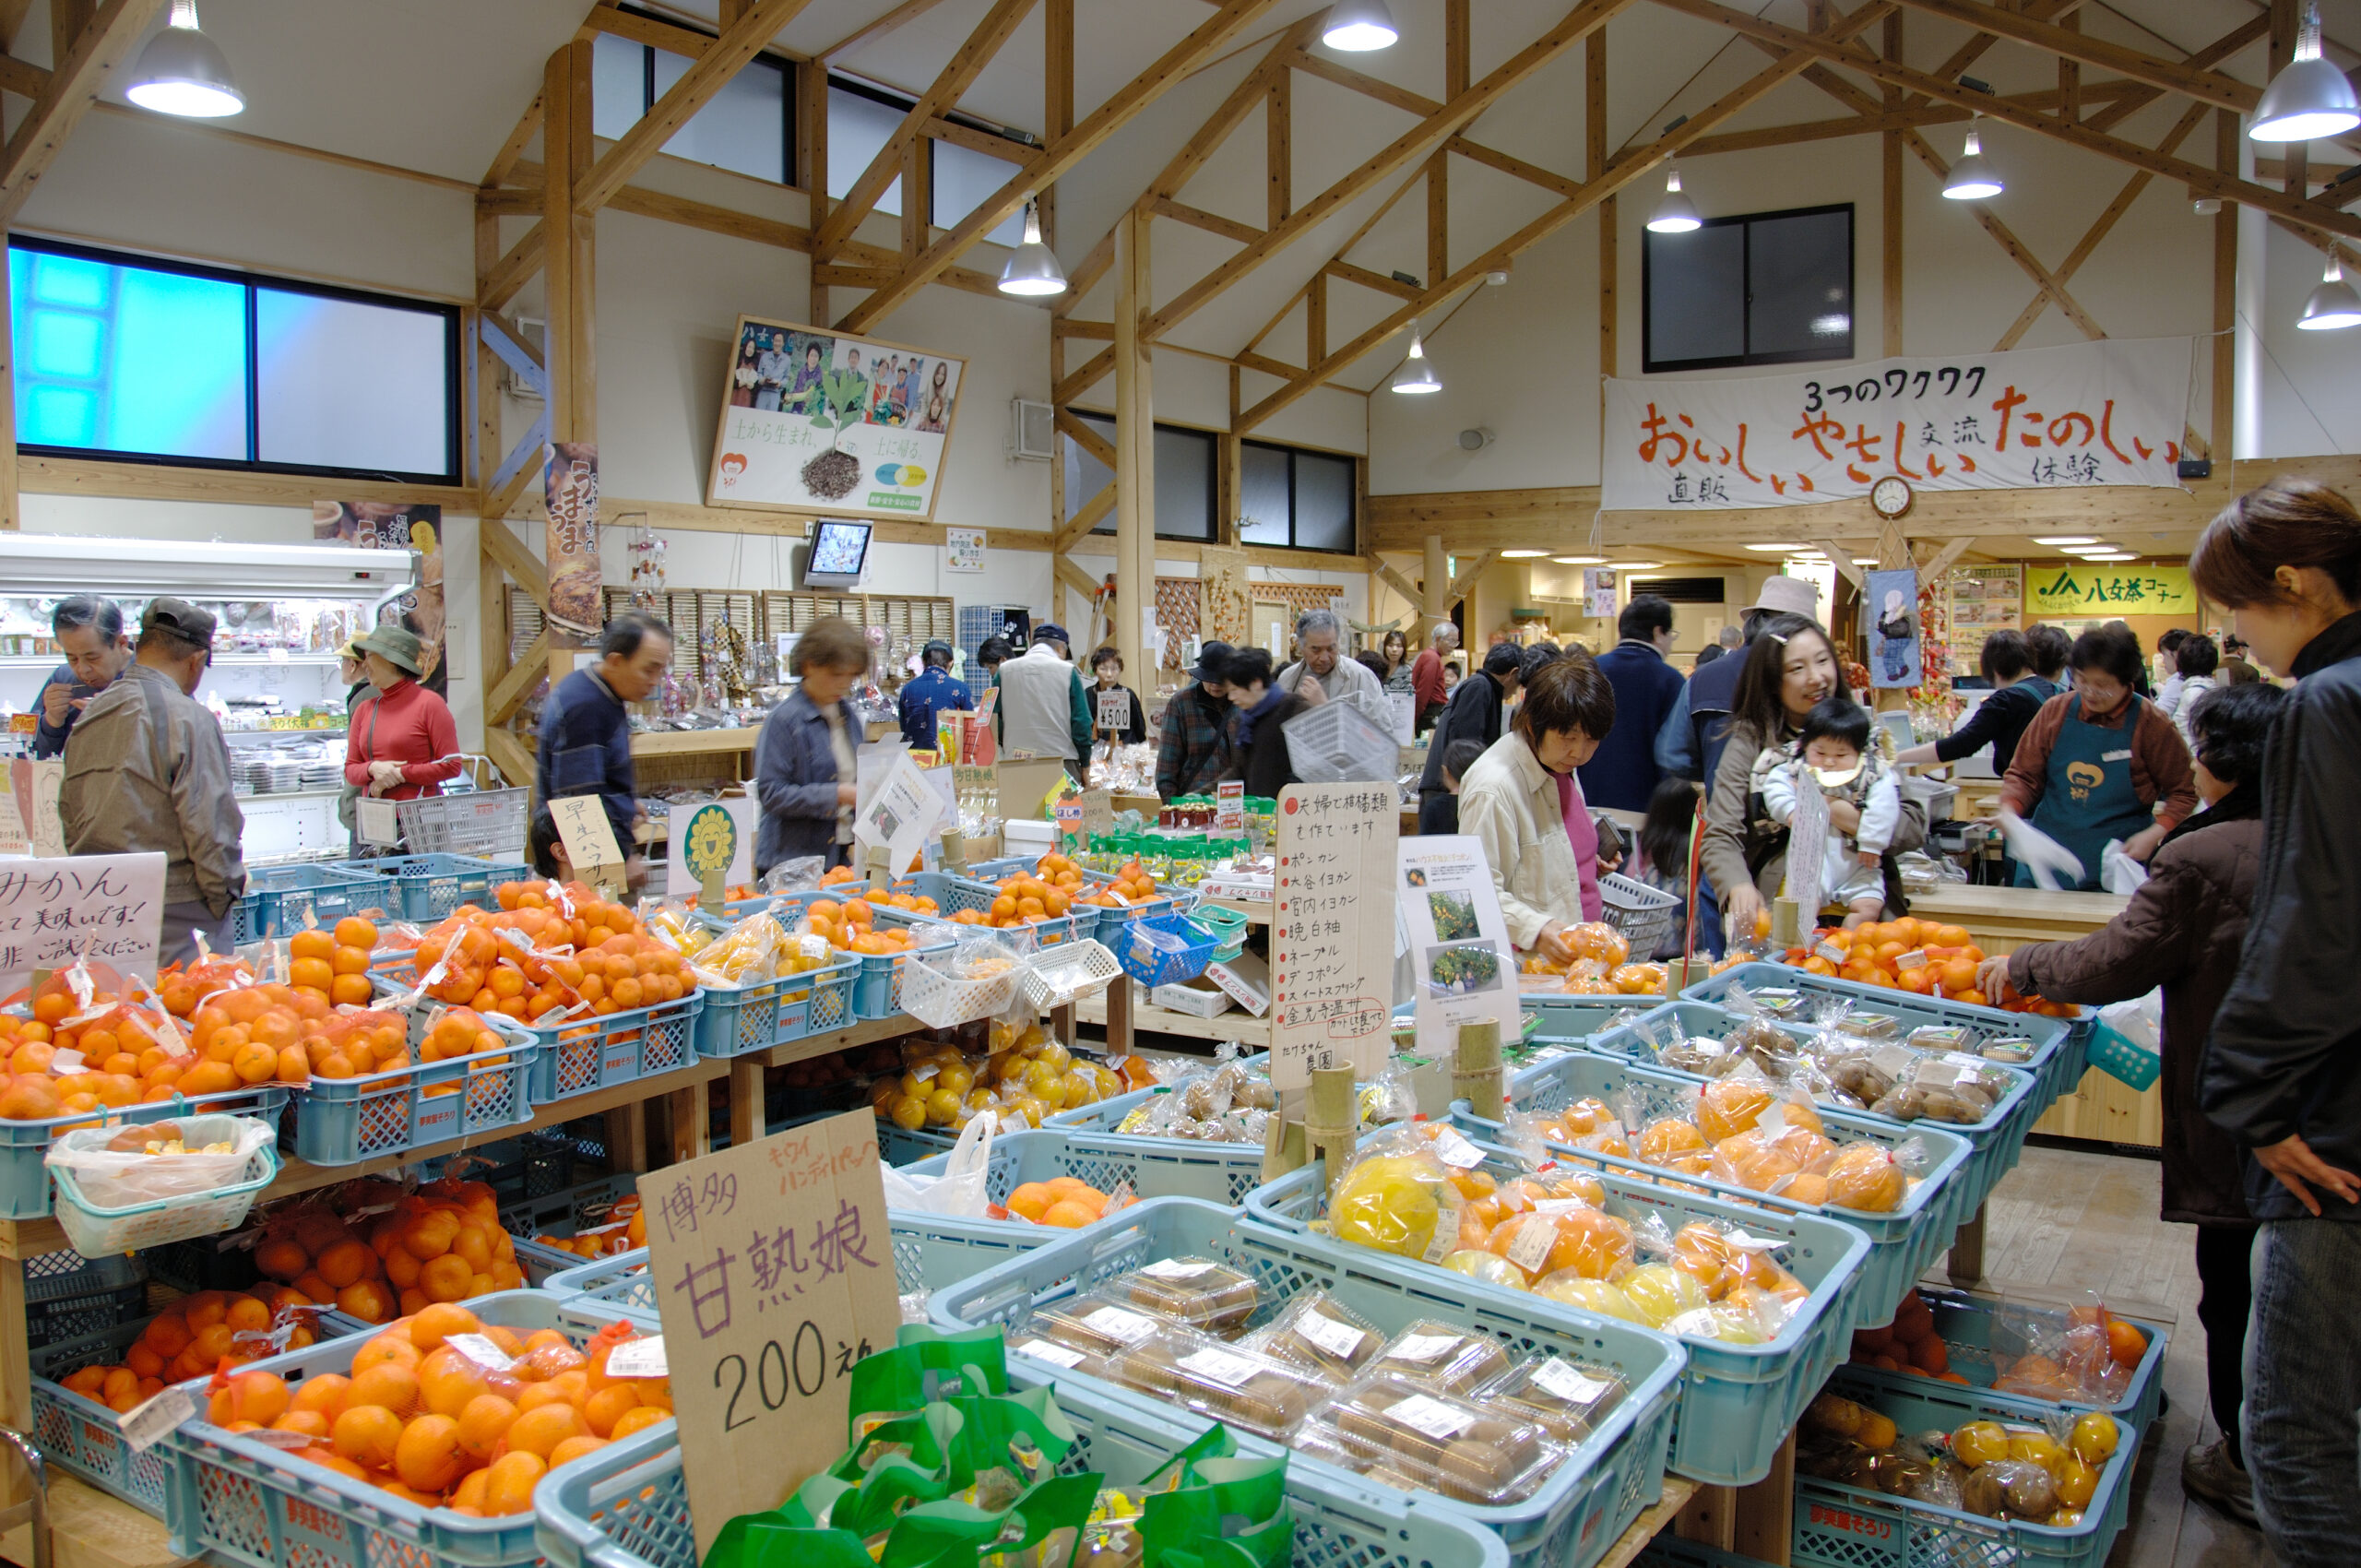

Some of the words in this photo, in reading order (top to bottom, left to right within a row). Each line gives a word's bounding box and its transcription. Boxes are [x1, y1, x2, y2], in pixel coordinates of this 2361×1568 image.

[1805, 367, 1987, 412] 3つのワクワク
[1920, 416, 1987, 447] 交流
[1992, 386, 2180, 466] たのしい
[1639, 402, 1814, 494] おいしい
[1792, 411, 1975, 483] やさしい
[2032, 452, 2104, 484] 体験
[1667, 474, 1729, 505] 直販
[1100, 708, 1128, 726] ¥500
[1291, 851, 1339, 868] ポンカン
[1290, 872, 1353, 890] 大谷イヨカン
[1289, 895, 1358, 917] 宮内イヨカン
[1289, 944, 1340, 966] ネーブル
[1288, 963, 1347, 988] デコポン
[768, 1135, 810, 1169] キウイ
[658, 1171, 737, 1243] 博多
[674, 1199, 880, 1340] 甘熟娘
